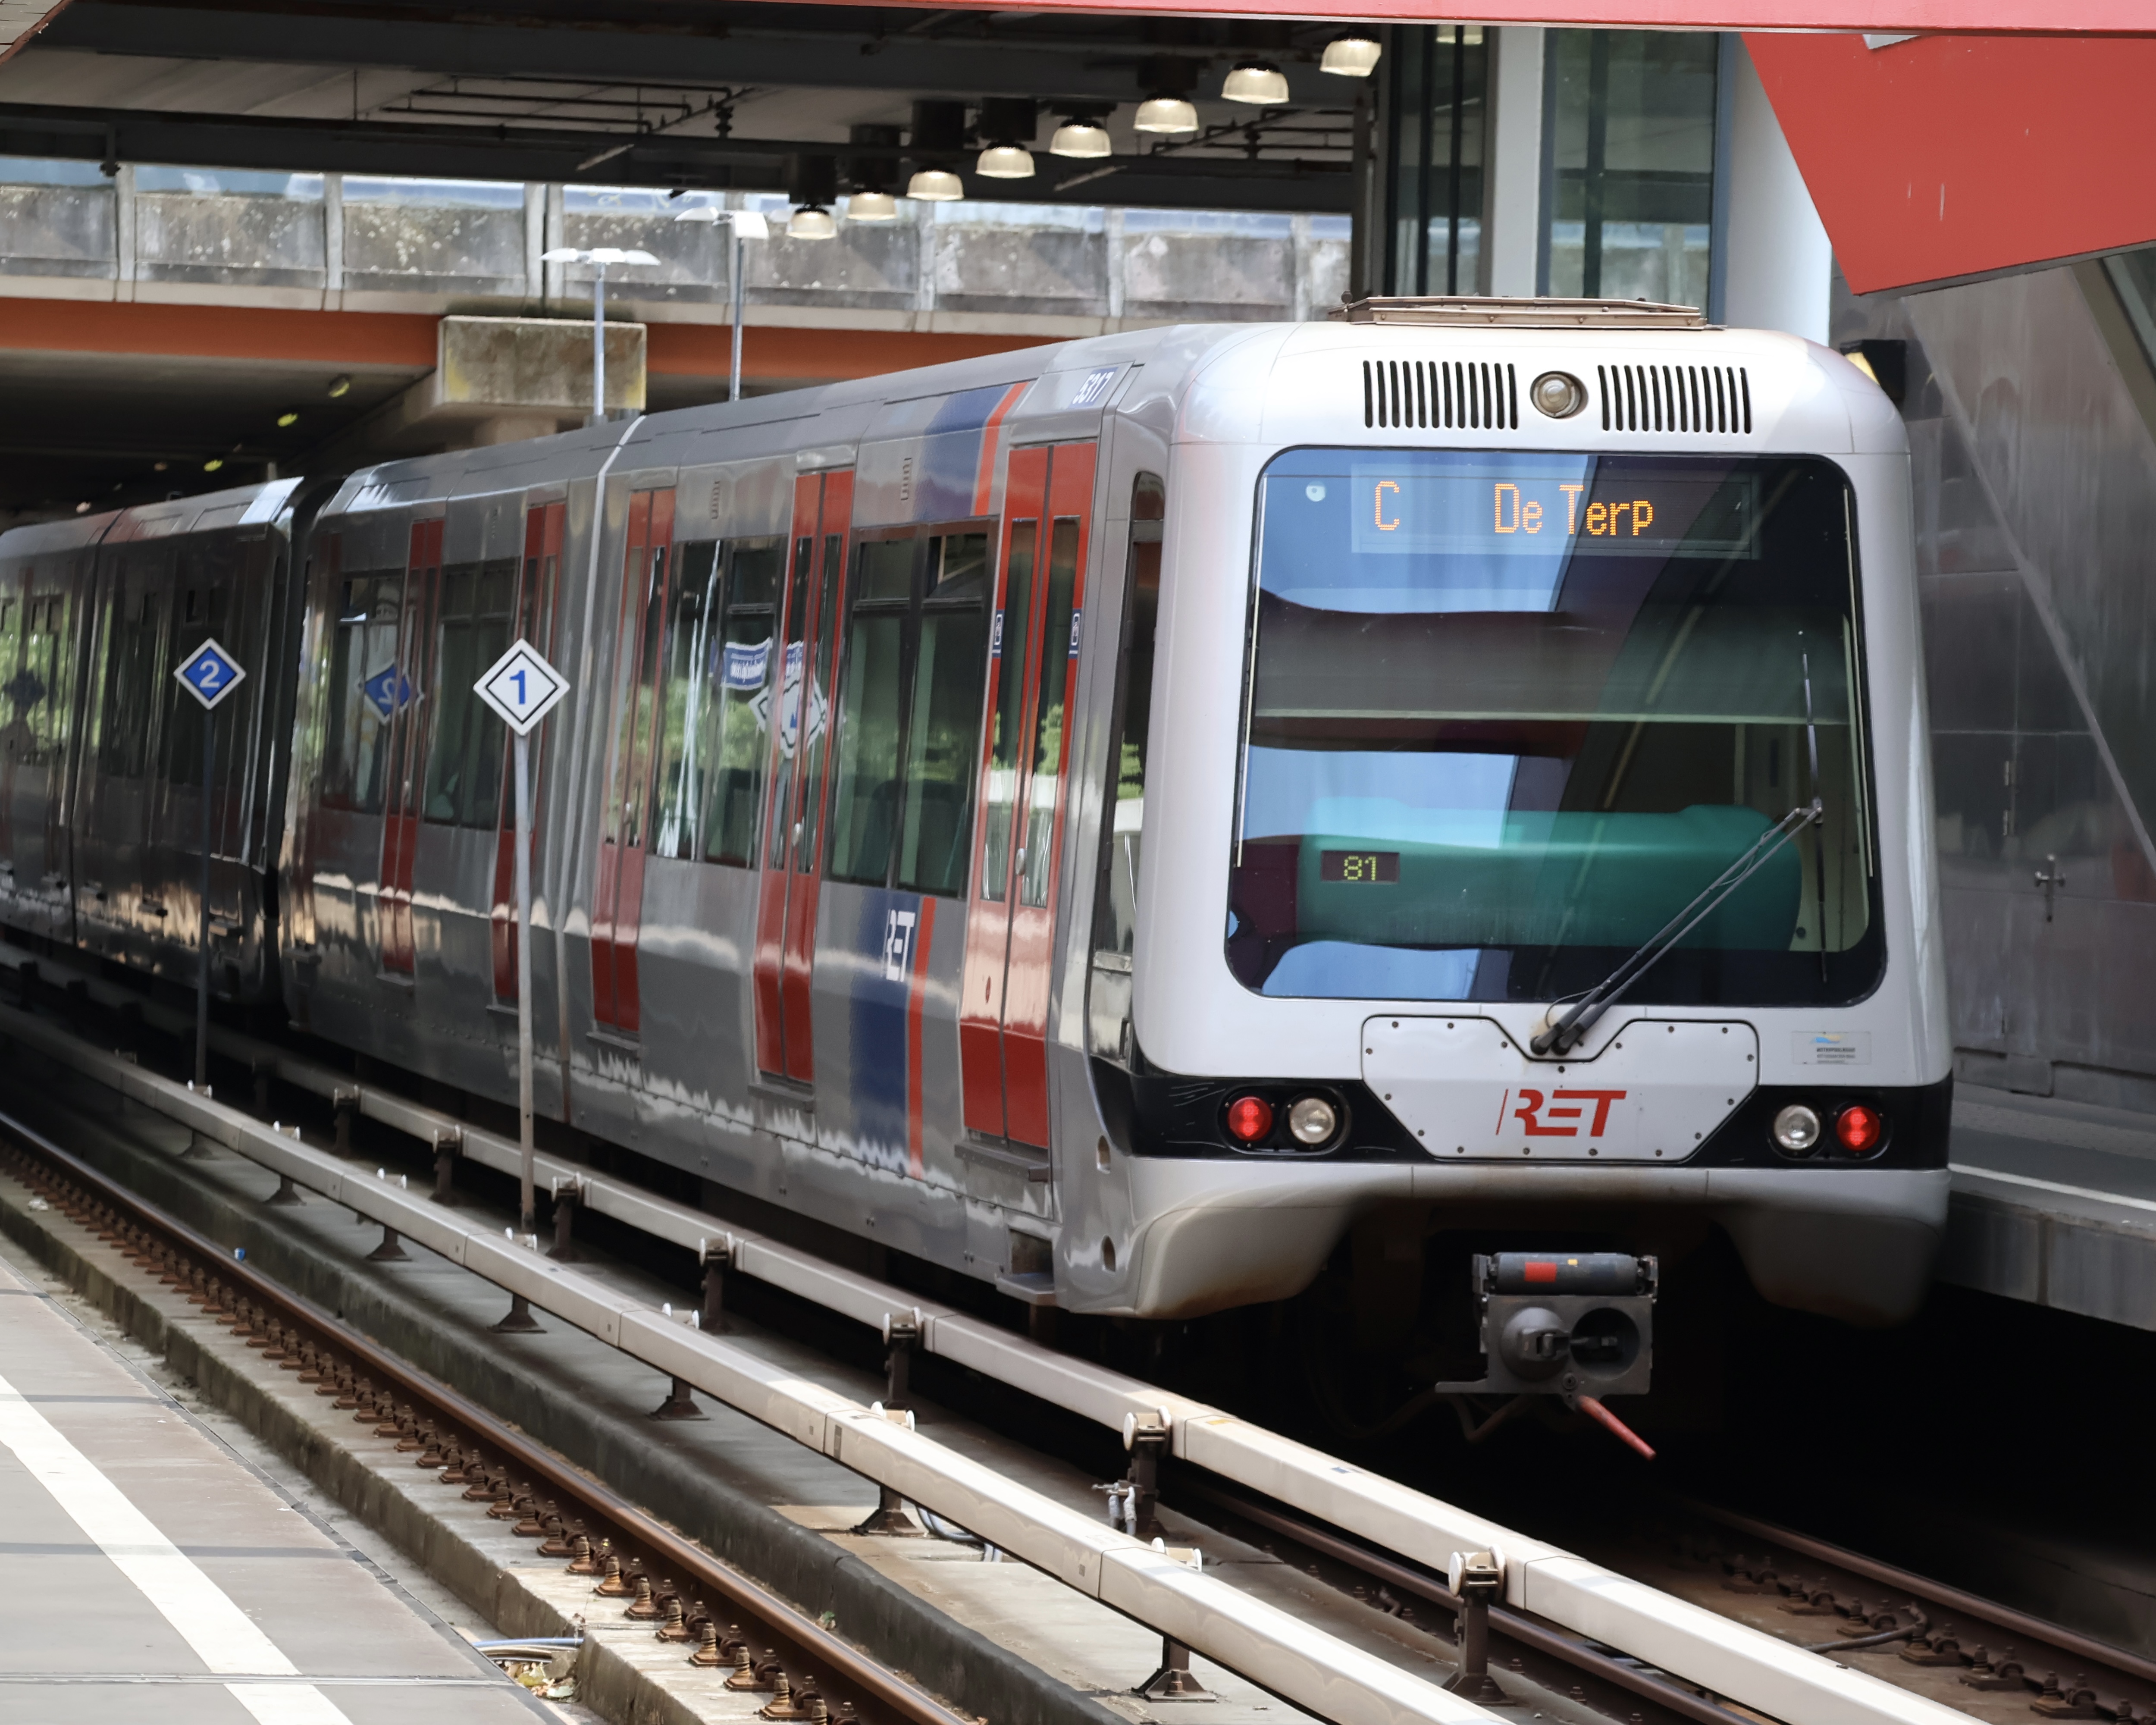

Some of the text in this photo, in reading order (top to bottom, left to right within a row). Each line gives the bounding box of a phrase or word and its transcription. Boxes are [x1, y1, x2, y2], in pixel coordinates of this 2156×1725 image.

[1072, 371, 1115, 405] 5317
[1375, 481, 1653, 536] C De Terp
[199, 659, 219, 688] 2
[509, 669, 526, 705] 1
[1344, 855, 1376, 881] 81
[886, 910, 916, 982] RET
[1514, 1088, 1627, 1137] RET
